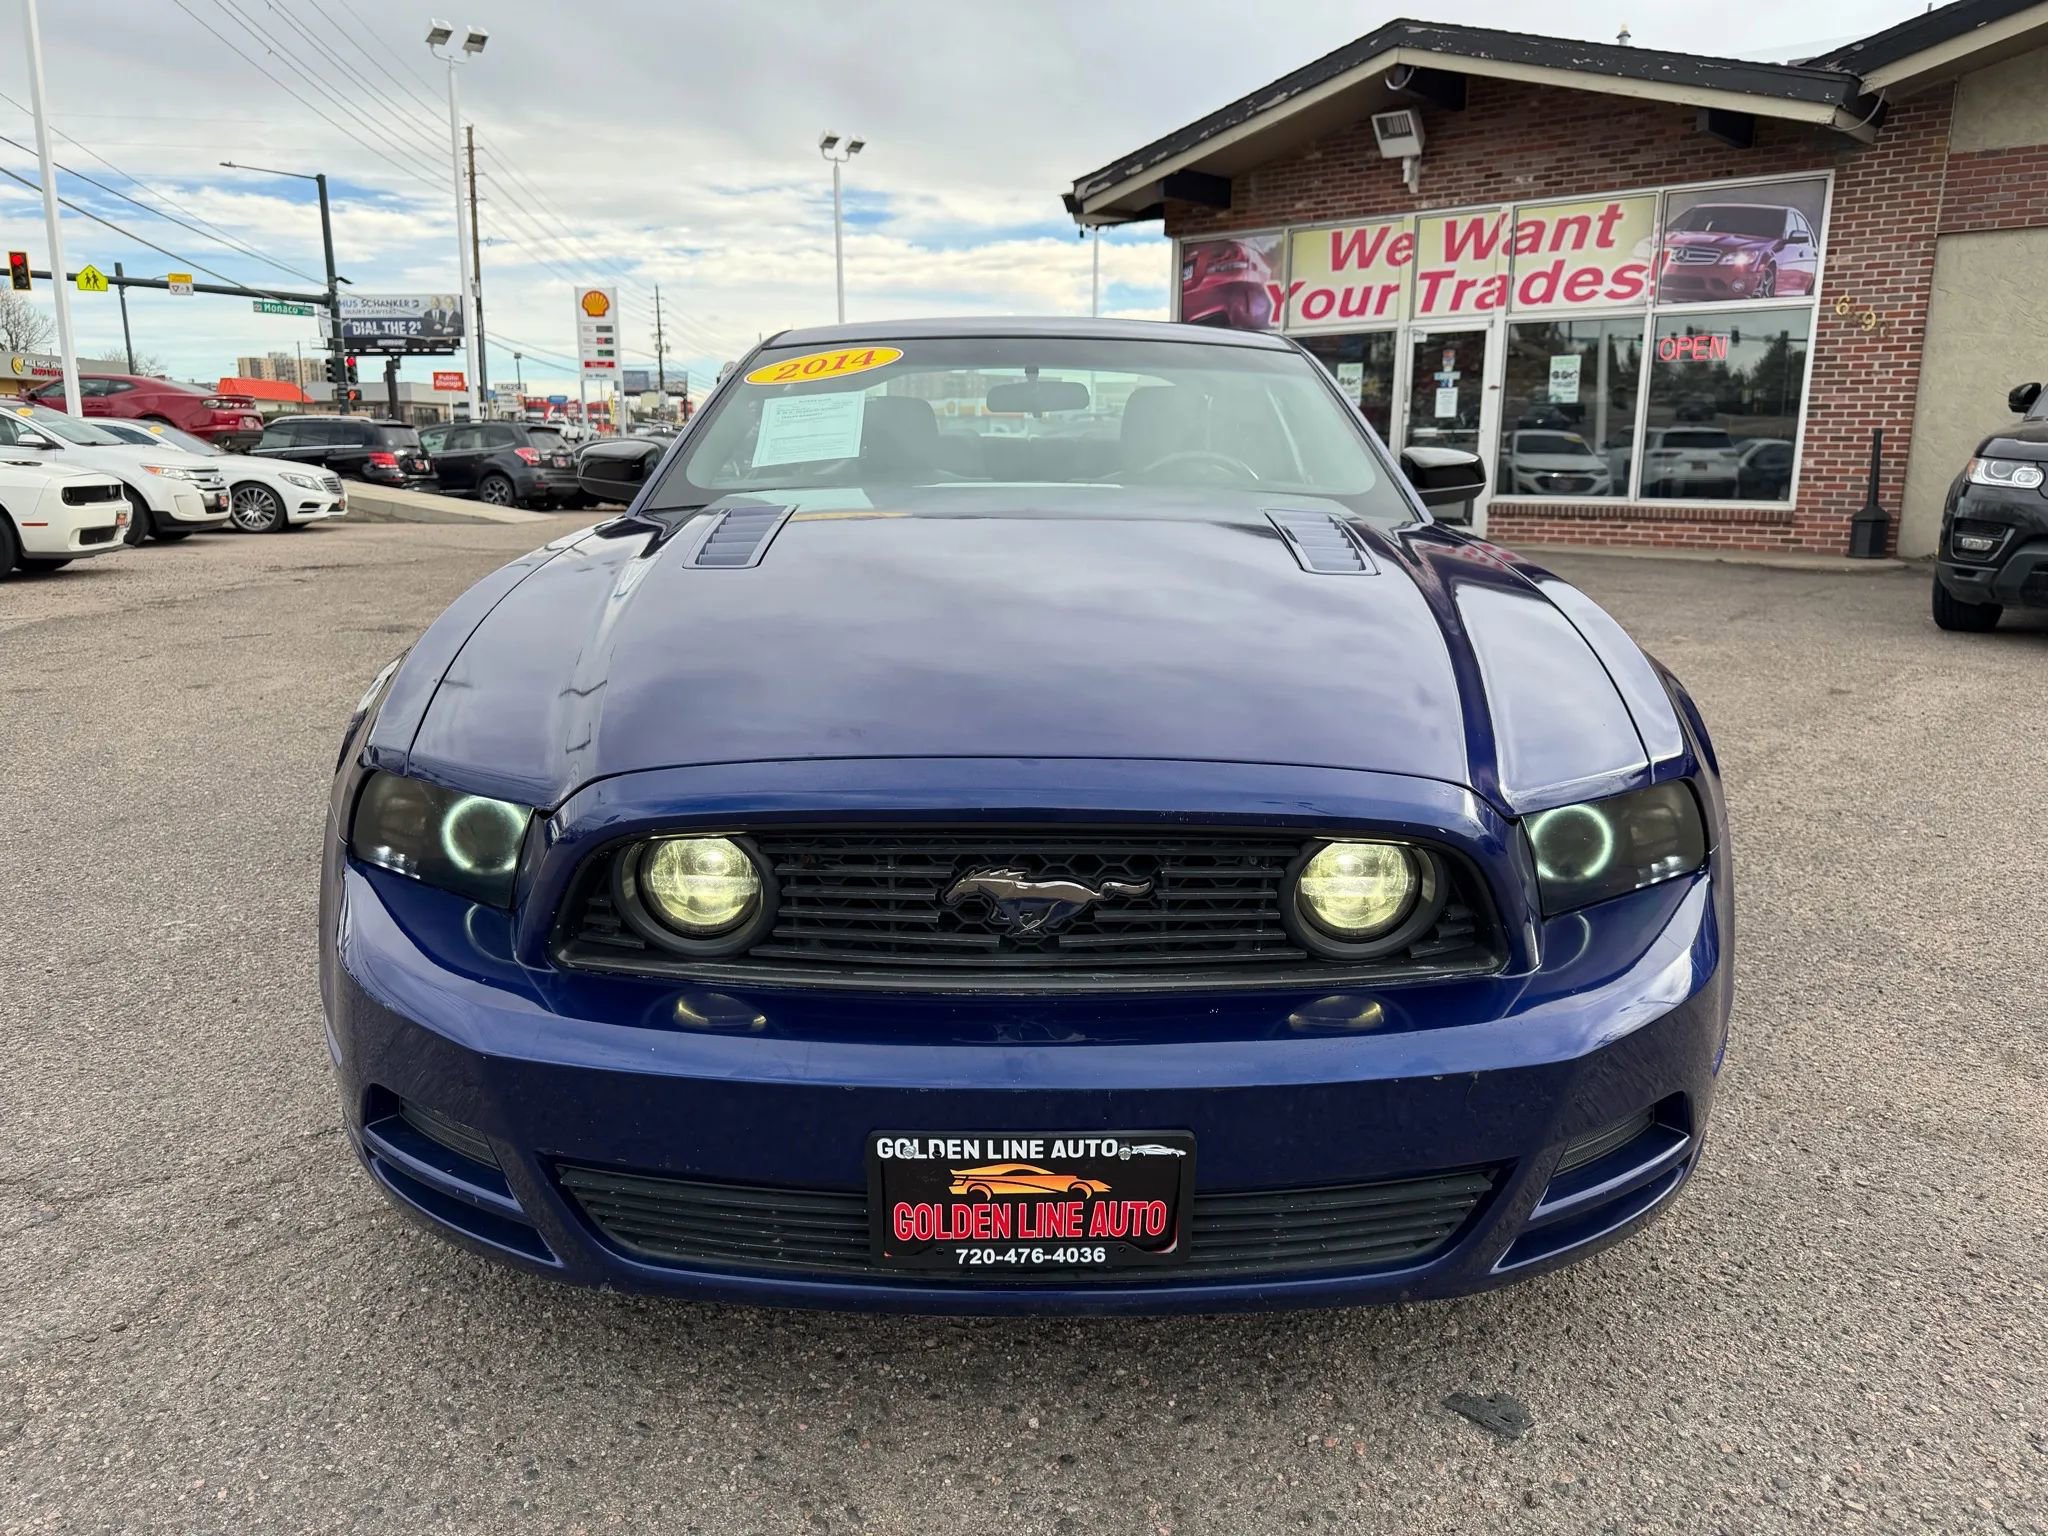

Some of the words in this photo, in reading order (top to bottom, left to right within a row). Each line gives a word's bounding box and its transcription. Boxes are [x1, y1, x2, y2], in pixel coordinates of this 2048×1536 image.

[1330, 226, 1415, 272] We
[1444, 203, 1623, 263] Want
[1266, 280, 1401, 325] Your
[1417, 250, 1672, 314] Trades!
[263, 303, 299, 315] Monaco
[361, 298, 412, 309] SCHANKER
[352, 320, 381, 336] DIAL
[382, 320, 406, 336] THE
[1658, 335, 1728, 362] OPEN
[773, 350, 877, 381] 2014
[876, 1137, 980, 1160] GOLDEN
[987, 1139, 1044, 1160] LINE
[1050, 1138, 1119, 1159] AUTO
[893, 1201, 1012, 1241] GOLDEN
[1018, 1201, 1084, 1240] LINE
[1088, 1199, 1168, 1238] AUTO
[955, 1246, 1107, 1265] 720-476-4036
